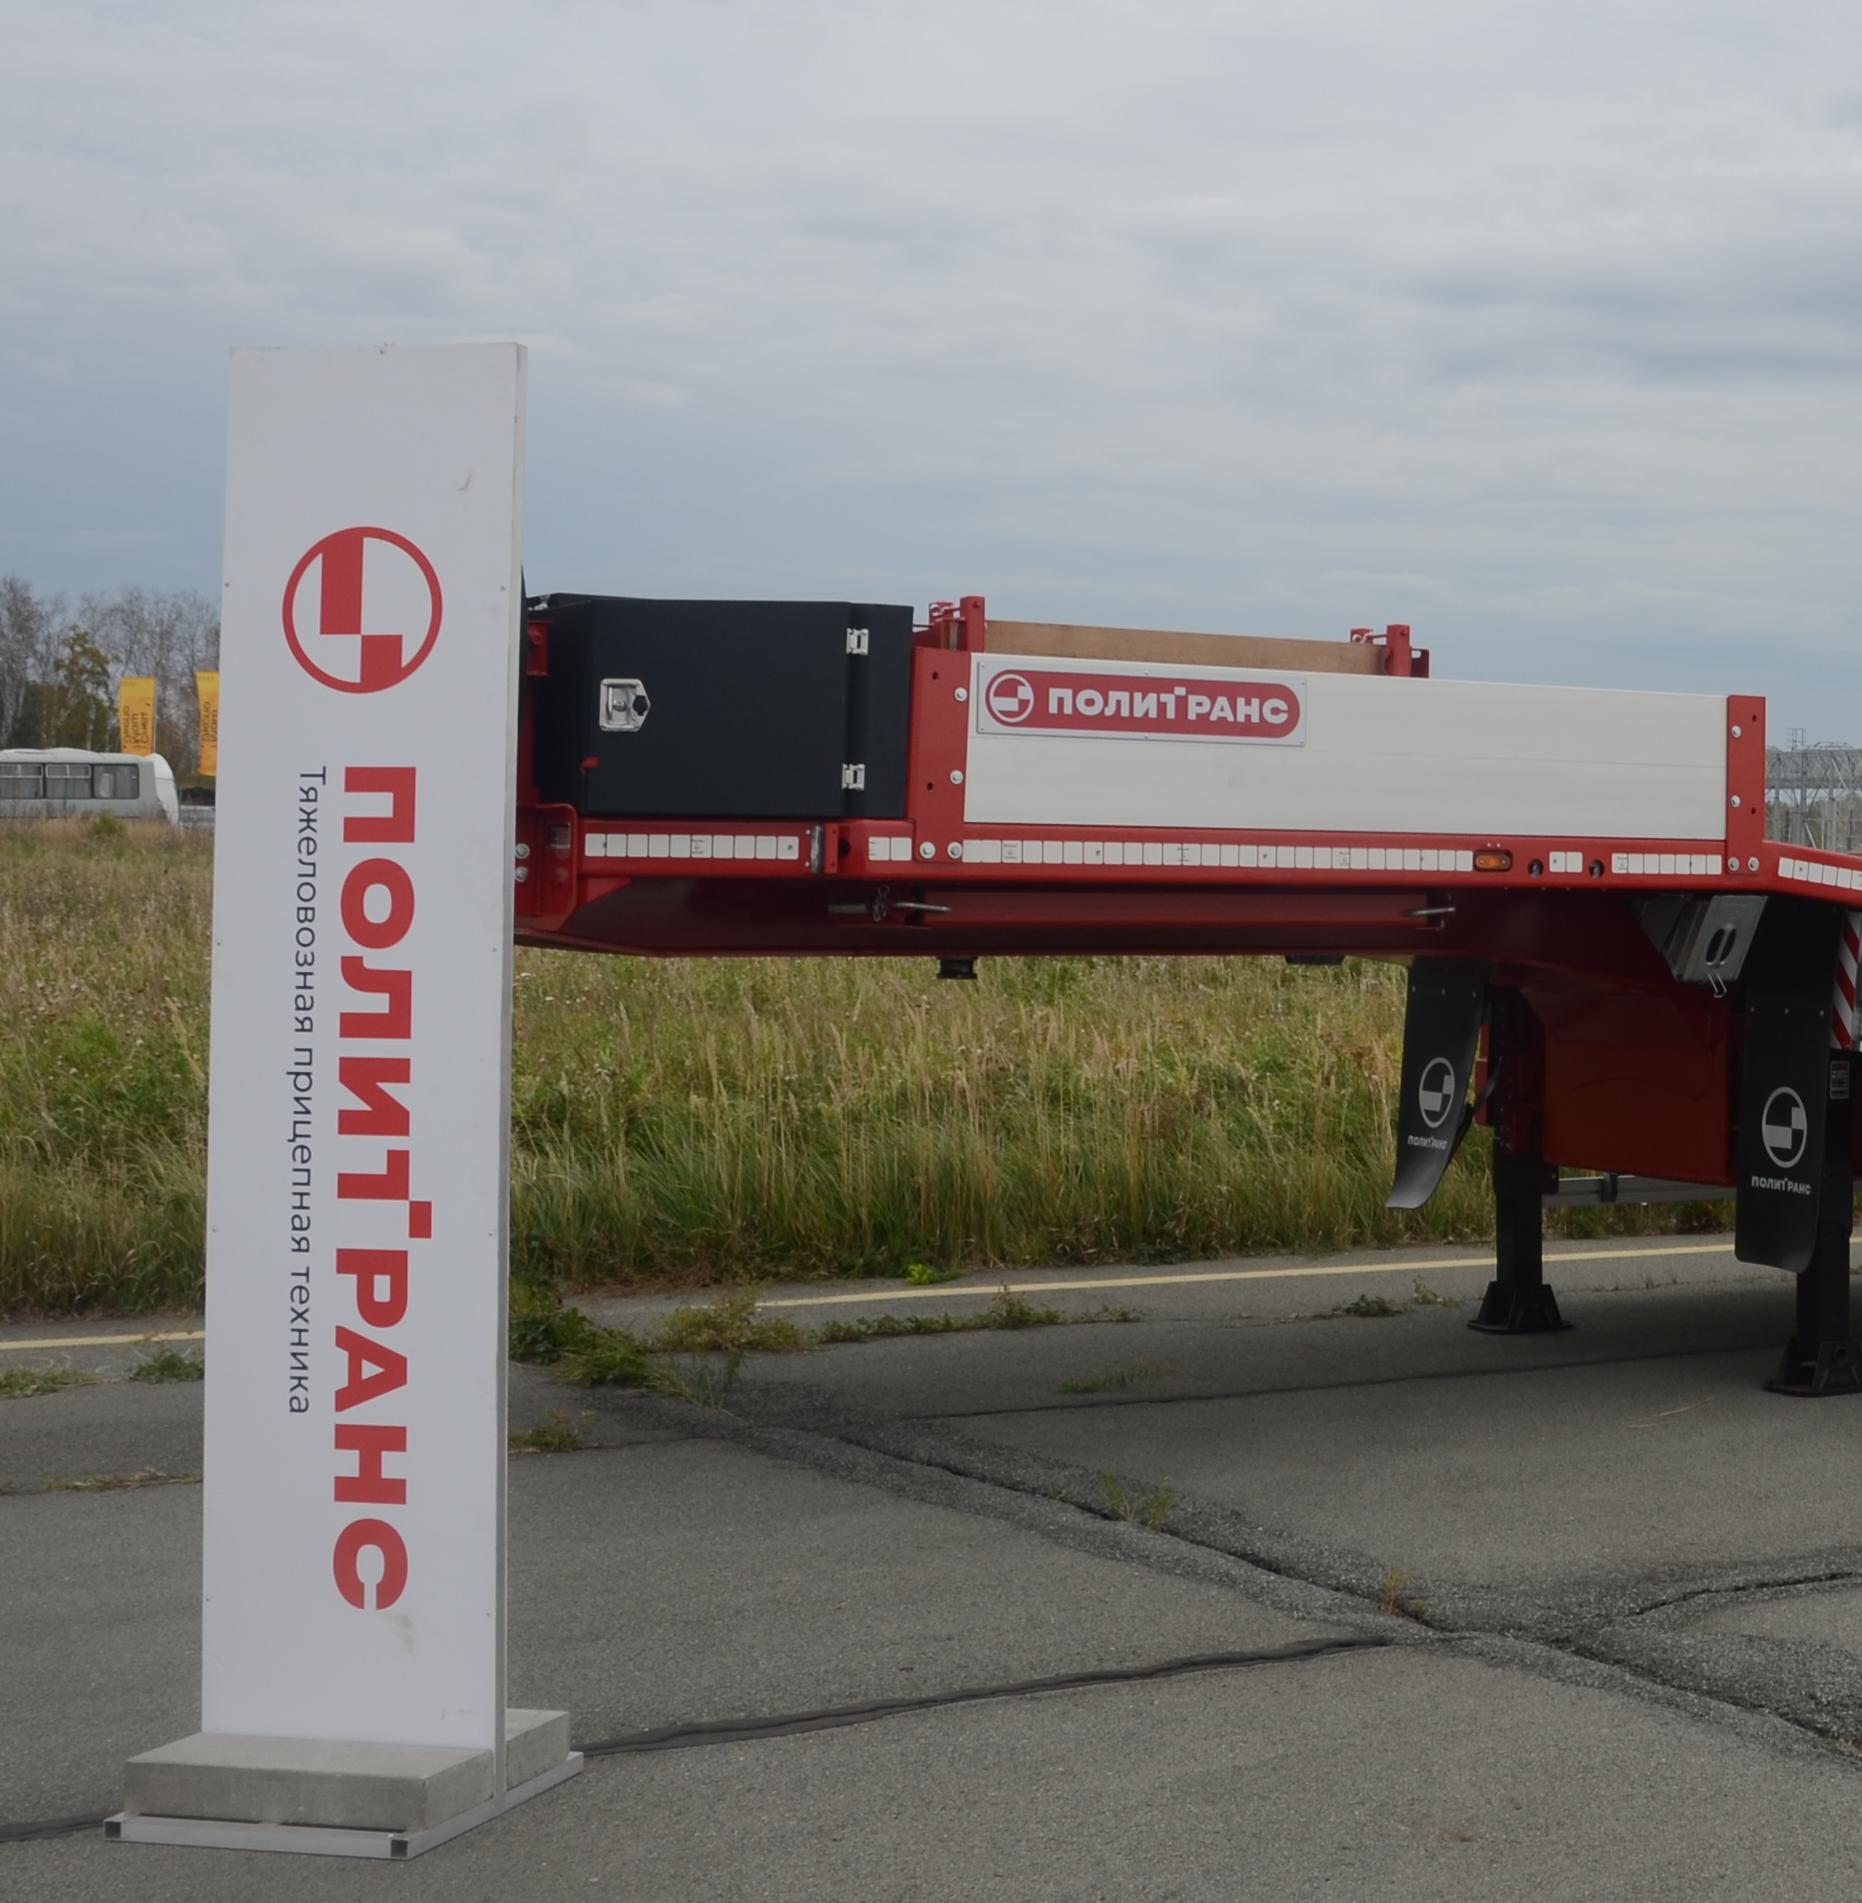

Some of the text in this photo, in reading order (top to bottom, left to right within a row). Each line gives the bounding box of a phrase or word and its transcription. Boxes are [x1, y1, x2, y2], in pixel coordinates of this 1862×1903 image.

[1048, 686, 1289, 725] ПОЛИТРАНС
[286, 765, 327, 1414] Тяжеловозная прицепная техника
[334, 766, 432, 1609] ПОЛИТРАНС
[1751, 1176, 1812, 1195] ПОЛИТРАНС
